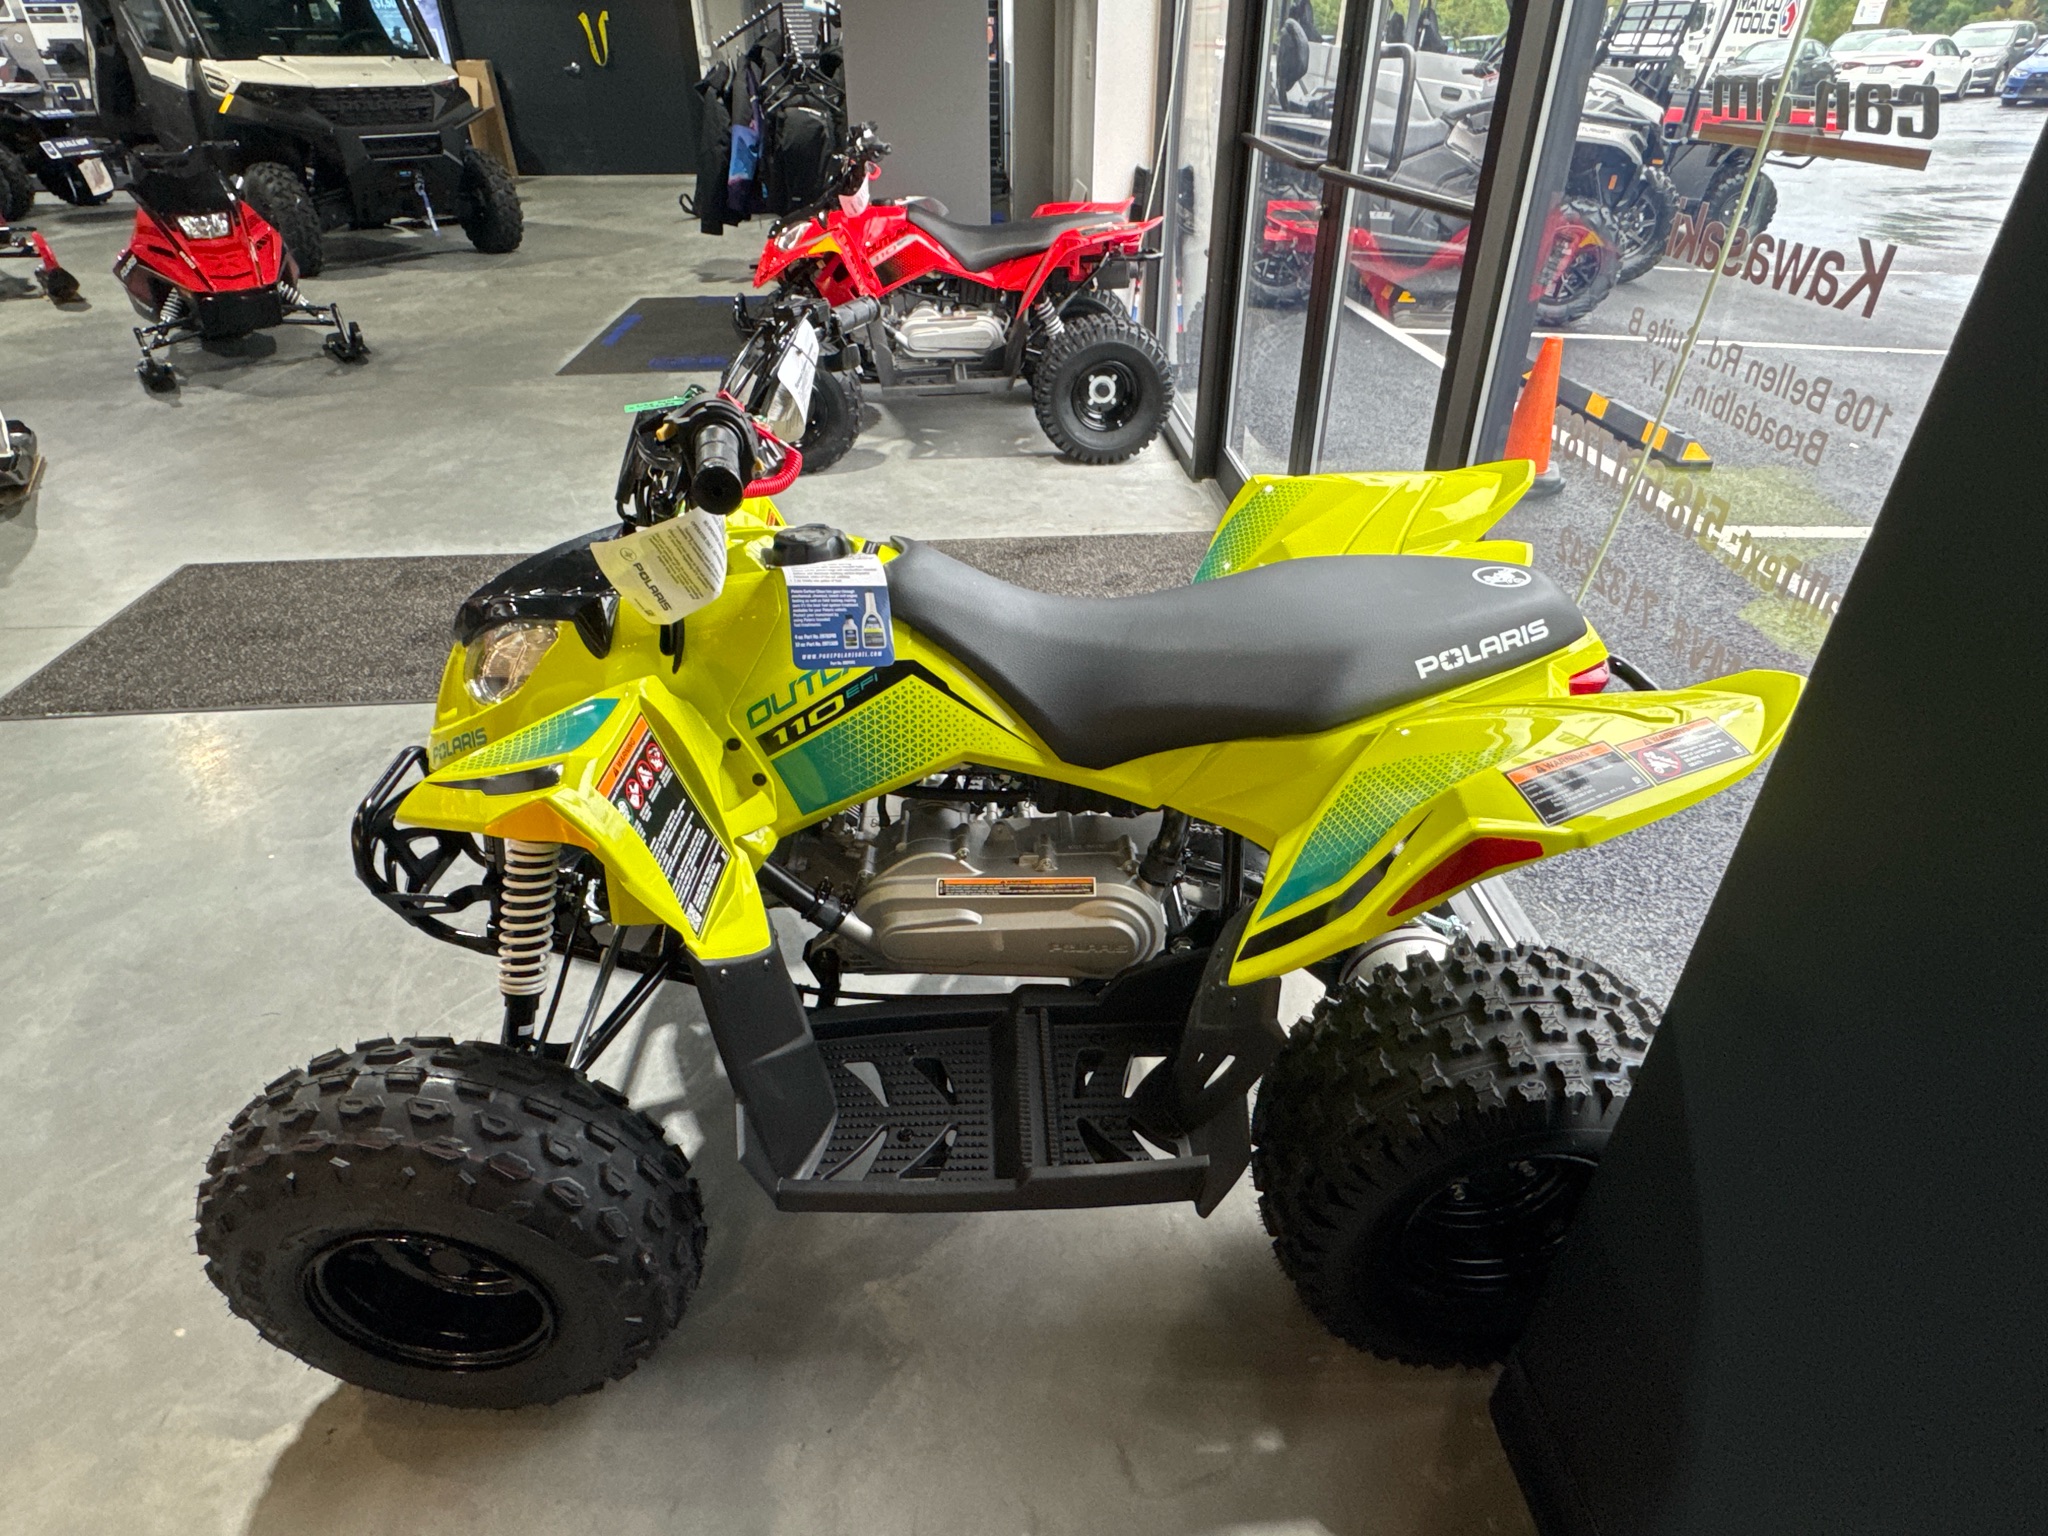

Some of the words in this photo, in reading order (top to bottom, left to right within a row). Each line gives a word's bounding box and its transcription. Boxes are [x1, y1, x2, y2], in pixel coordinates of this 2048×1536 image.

[1733, 12, 1778, 34] TOOLS
[633, 562, 673, 611] POLARIS
[1415, 618, 1550, 680] POLARIS
[772, 694, 845, 744] 110
[845, 673, 878, 699] EFI
[432, 726, 488, 763] POLARIS
[1543, 751, 1589, 769] WARNING
